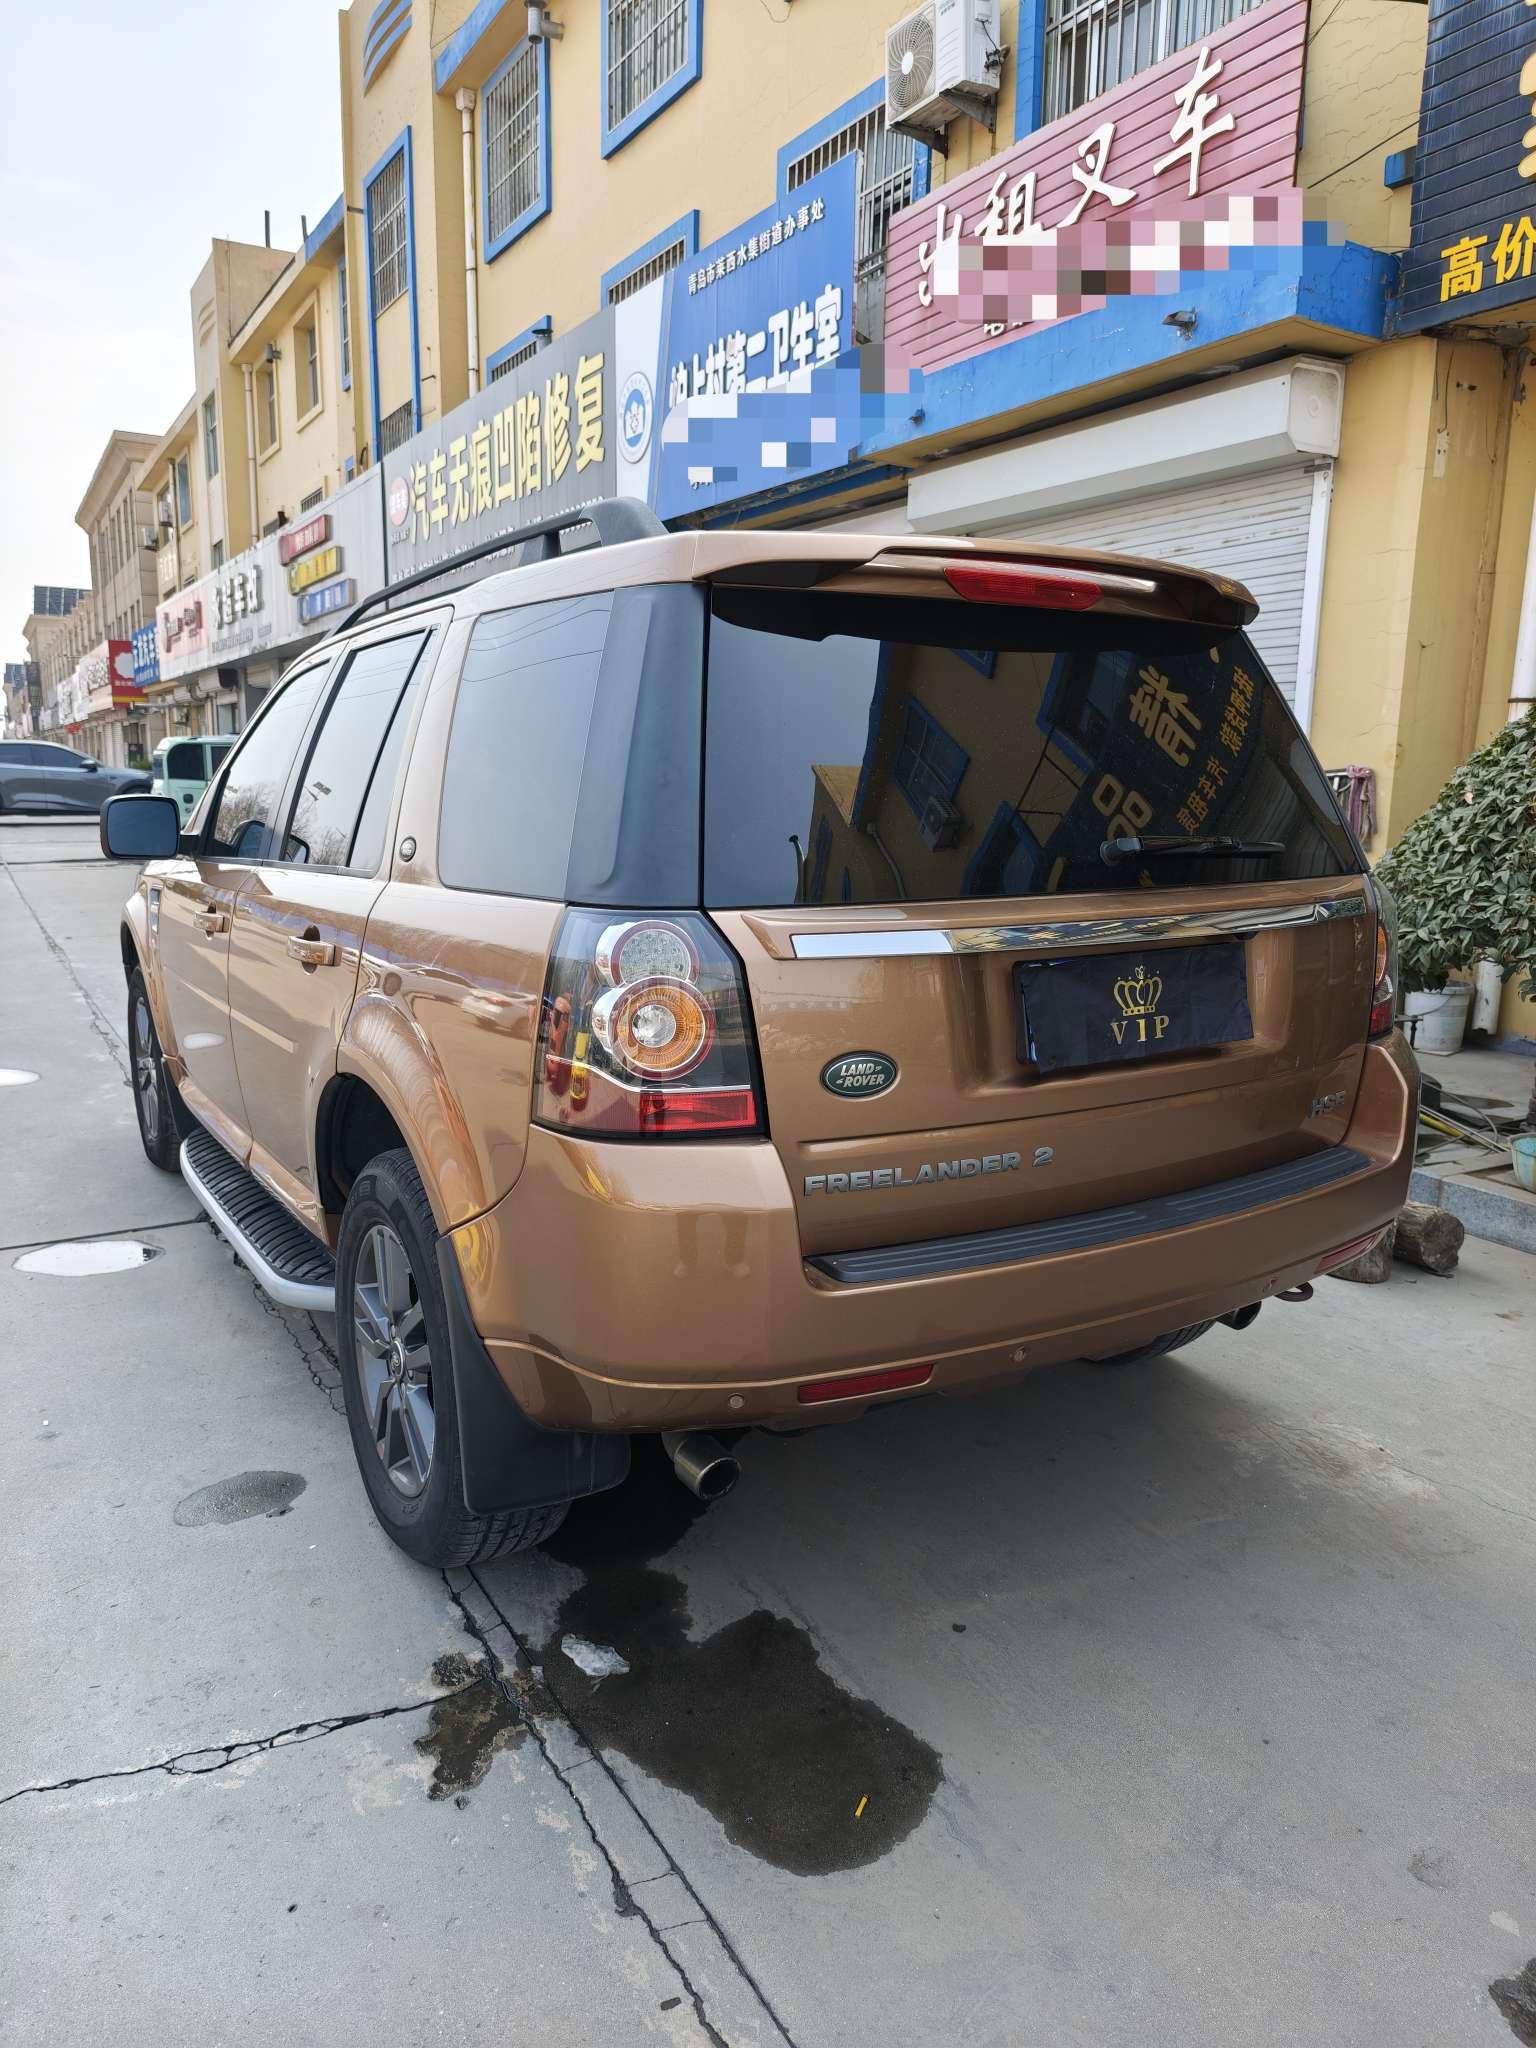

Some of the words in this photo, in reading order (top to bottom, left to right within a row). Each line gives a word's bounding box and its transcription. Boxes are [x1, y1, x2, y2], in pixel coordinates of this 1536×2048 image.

[687, 198, 826, 296] 青岛市莱西水集街道办事处
[410, 352, 604, 544] 汽车无痕凹陷修复
[1110, 1014, 1170, 1044] VIP
[841, 1063, 875, 1076] LAND
[843, 1073, 885, 1088] ROVER
[803, 1150, 1022, 1199] FREELANDER
[1032, 1145, 1055, 1169] 2
